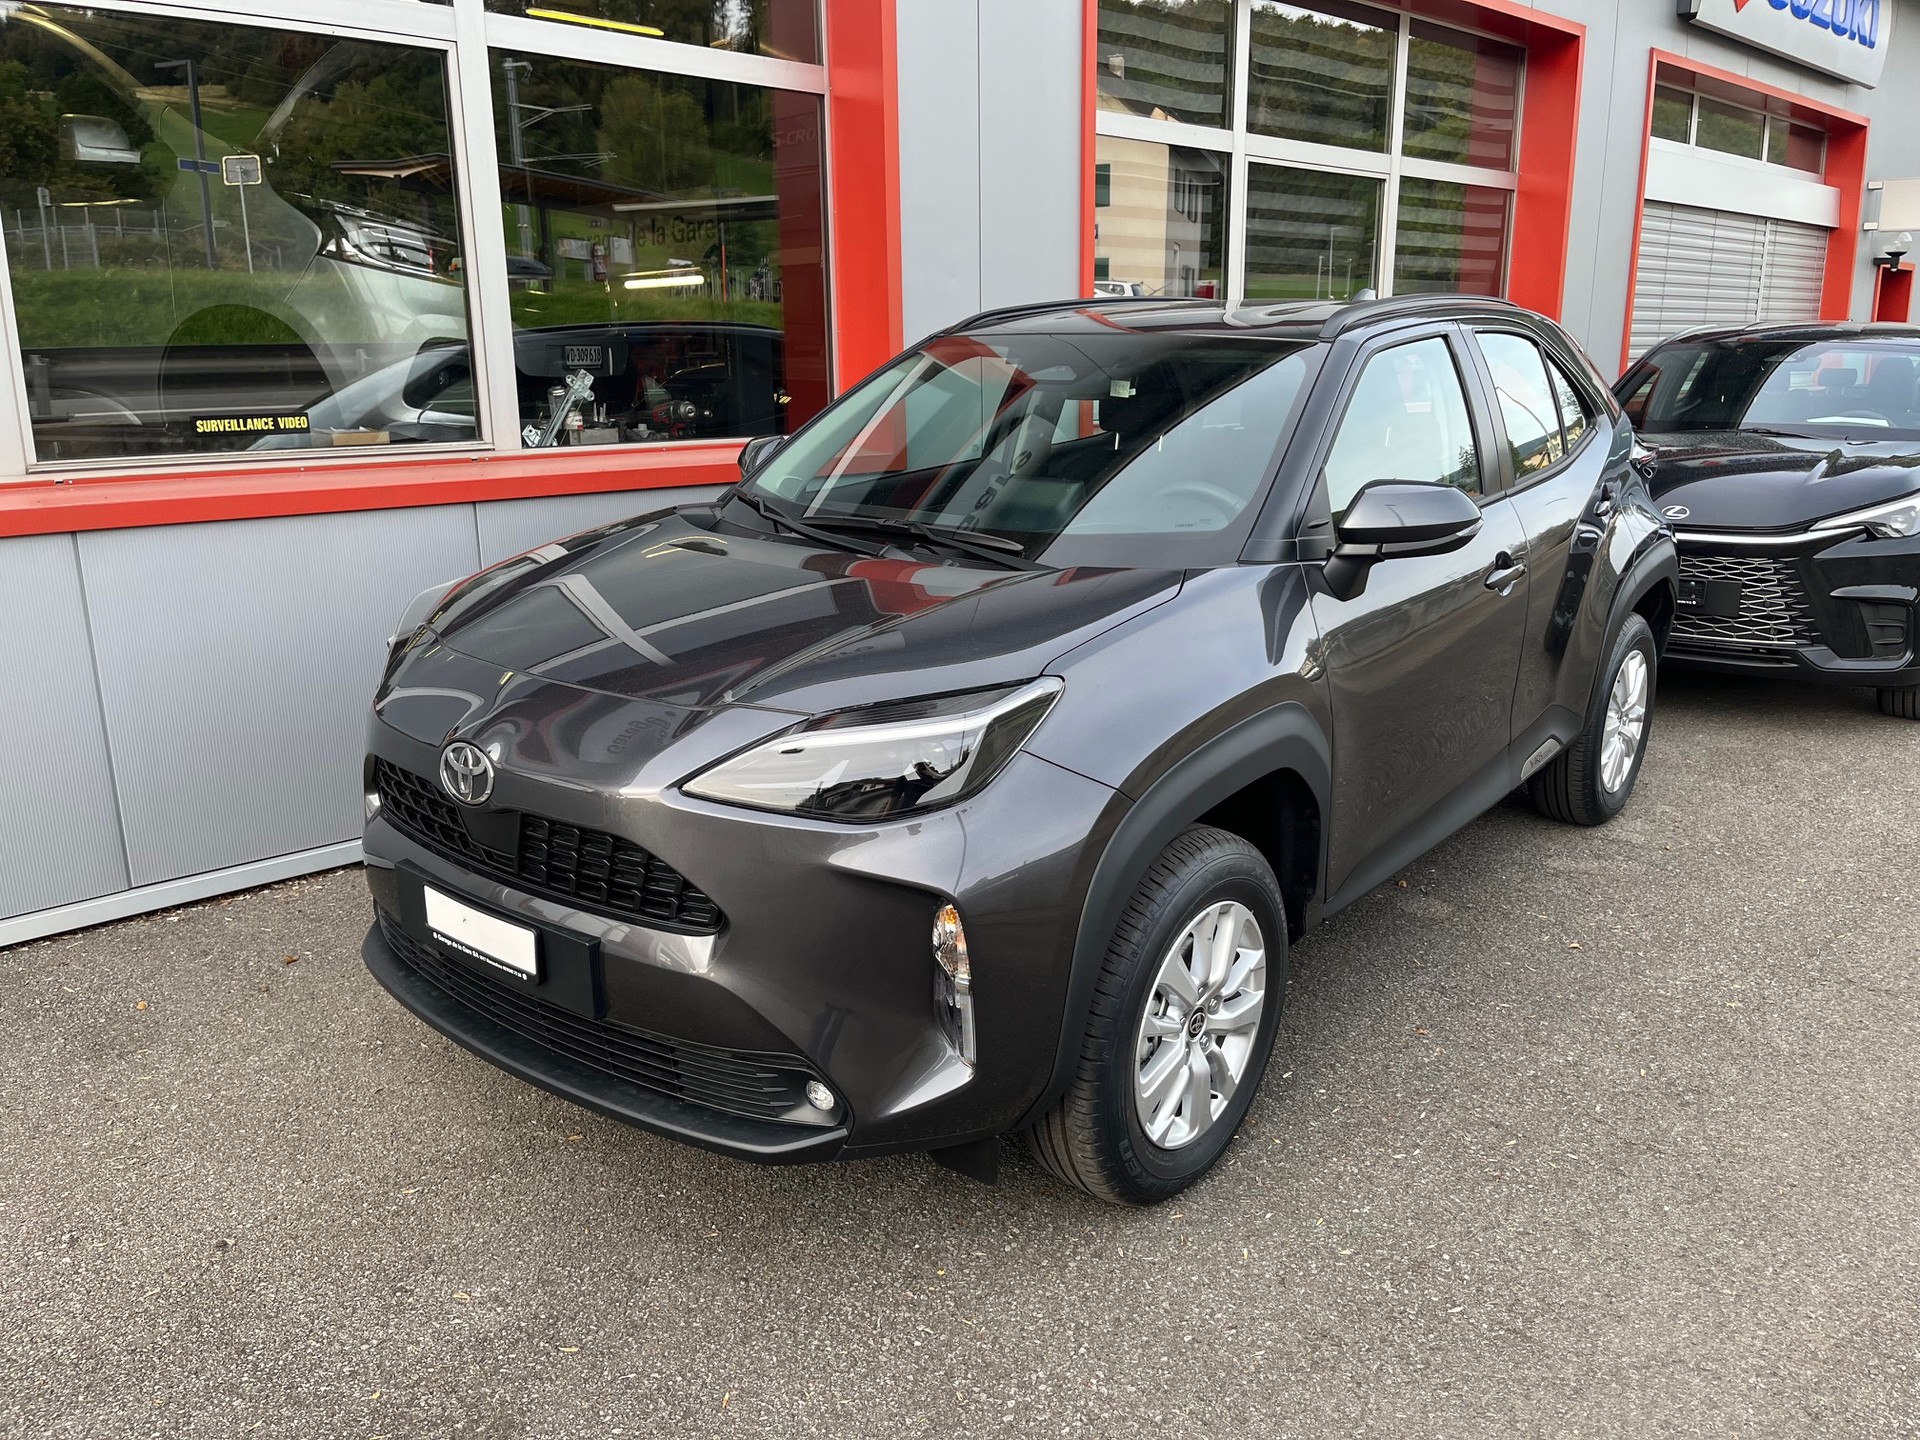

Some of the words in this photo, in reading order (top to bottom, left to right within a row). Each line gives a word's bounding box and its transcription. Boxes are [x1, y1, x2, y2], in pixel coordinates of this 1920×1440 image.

[1768, 0, 1881, 50] ZUKI
[651, 218, 666, 246] la
[671, 214, 716, 243] Gare
[196, 418, 275, 433] SURVEILLANCE
[277, 416, 308, 430] VIDEO
